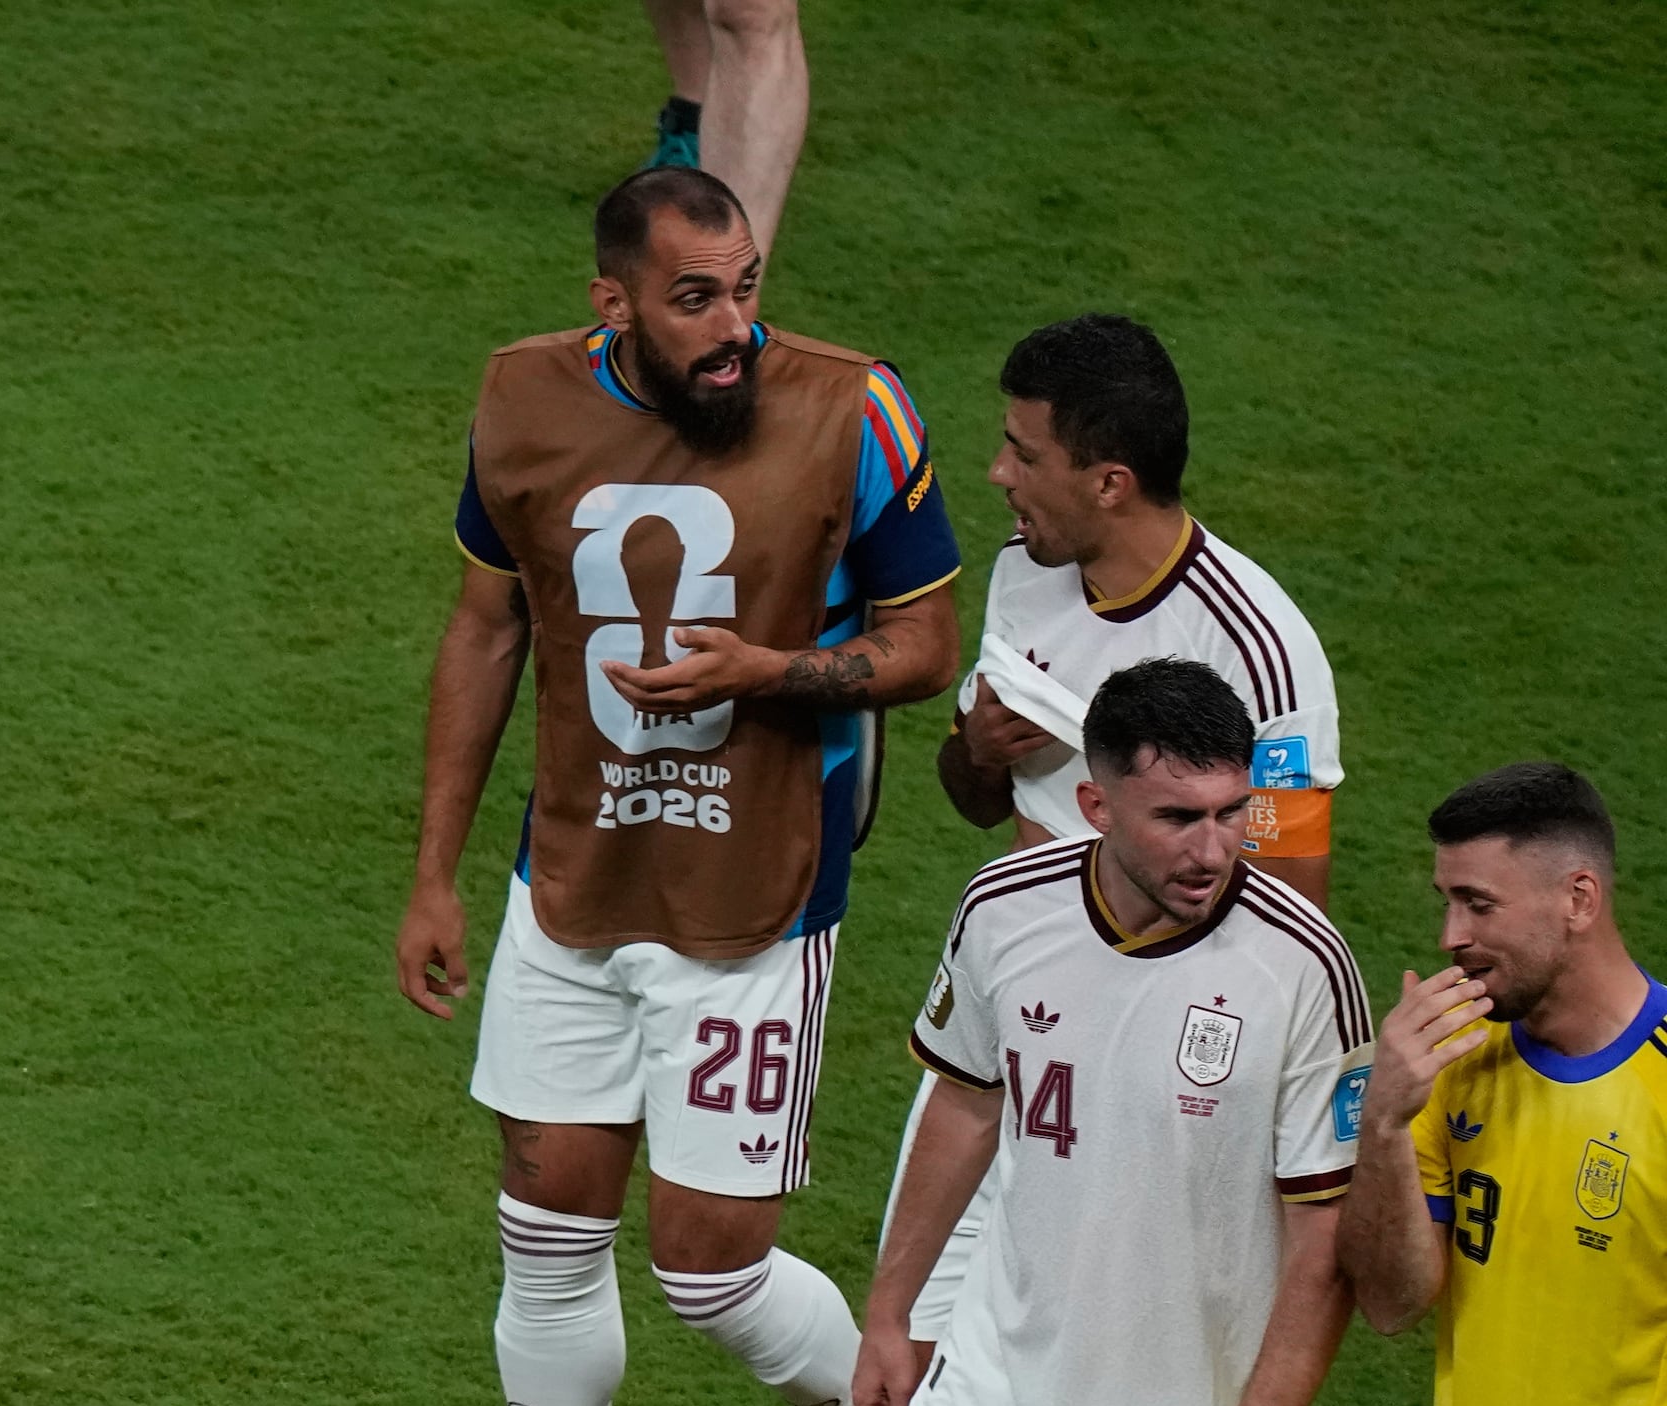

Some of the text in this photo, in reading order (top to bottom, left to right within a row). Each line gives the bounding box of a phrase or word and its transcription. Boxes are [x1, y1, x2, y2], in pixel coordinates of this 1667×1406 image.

[682, 763, 732, 789] CUP
[594, 788, 732, 834] 2026
[1247, 807, 1276, 825] TES
[686, 1015, 793, 1115] 26
[1004, 1048, 1079, 1159] 14
